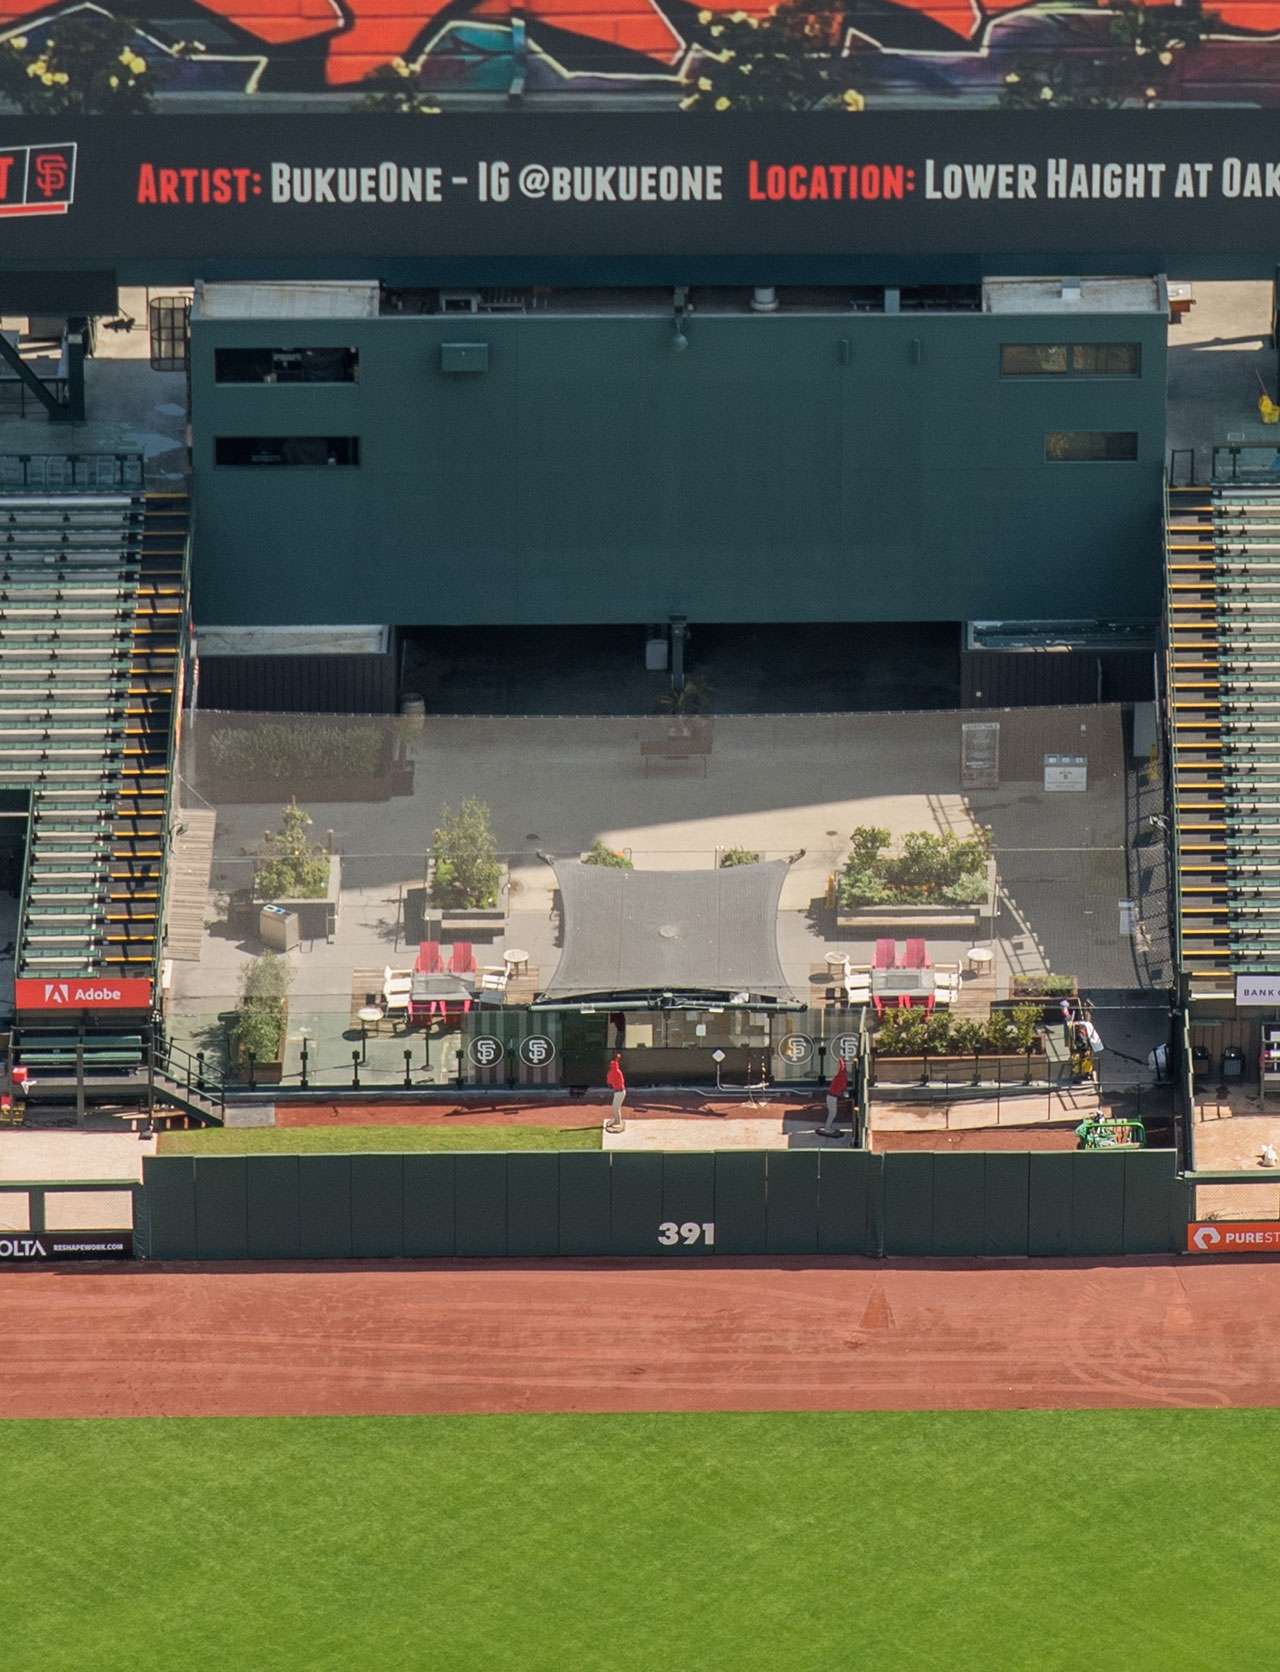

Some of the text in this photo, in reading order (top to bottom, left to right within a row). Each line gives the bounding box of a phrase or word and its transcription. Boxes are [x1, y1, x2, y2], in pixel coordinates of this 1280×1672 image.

[477, 161, 510, 201] IG
[75, 988, 121, 1001] Adobe
[1244, 988, 1274, 997] BANK
[658, 1222, 715, 1246] 391
